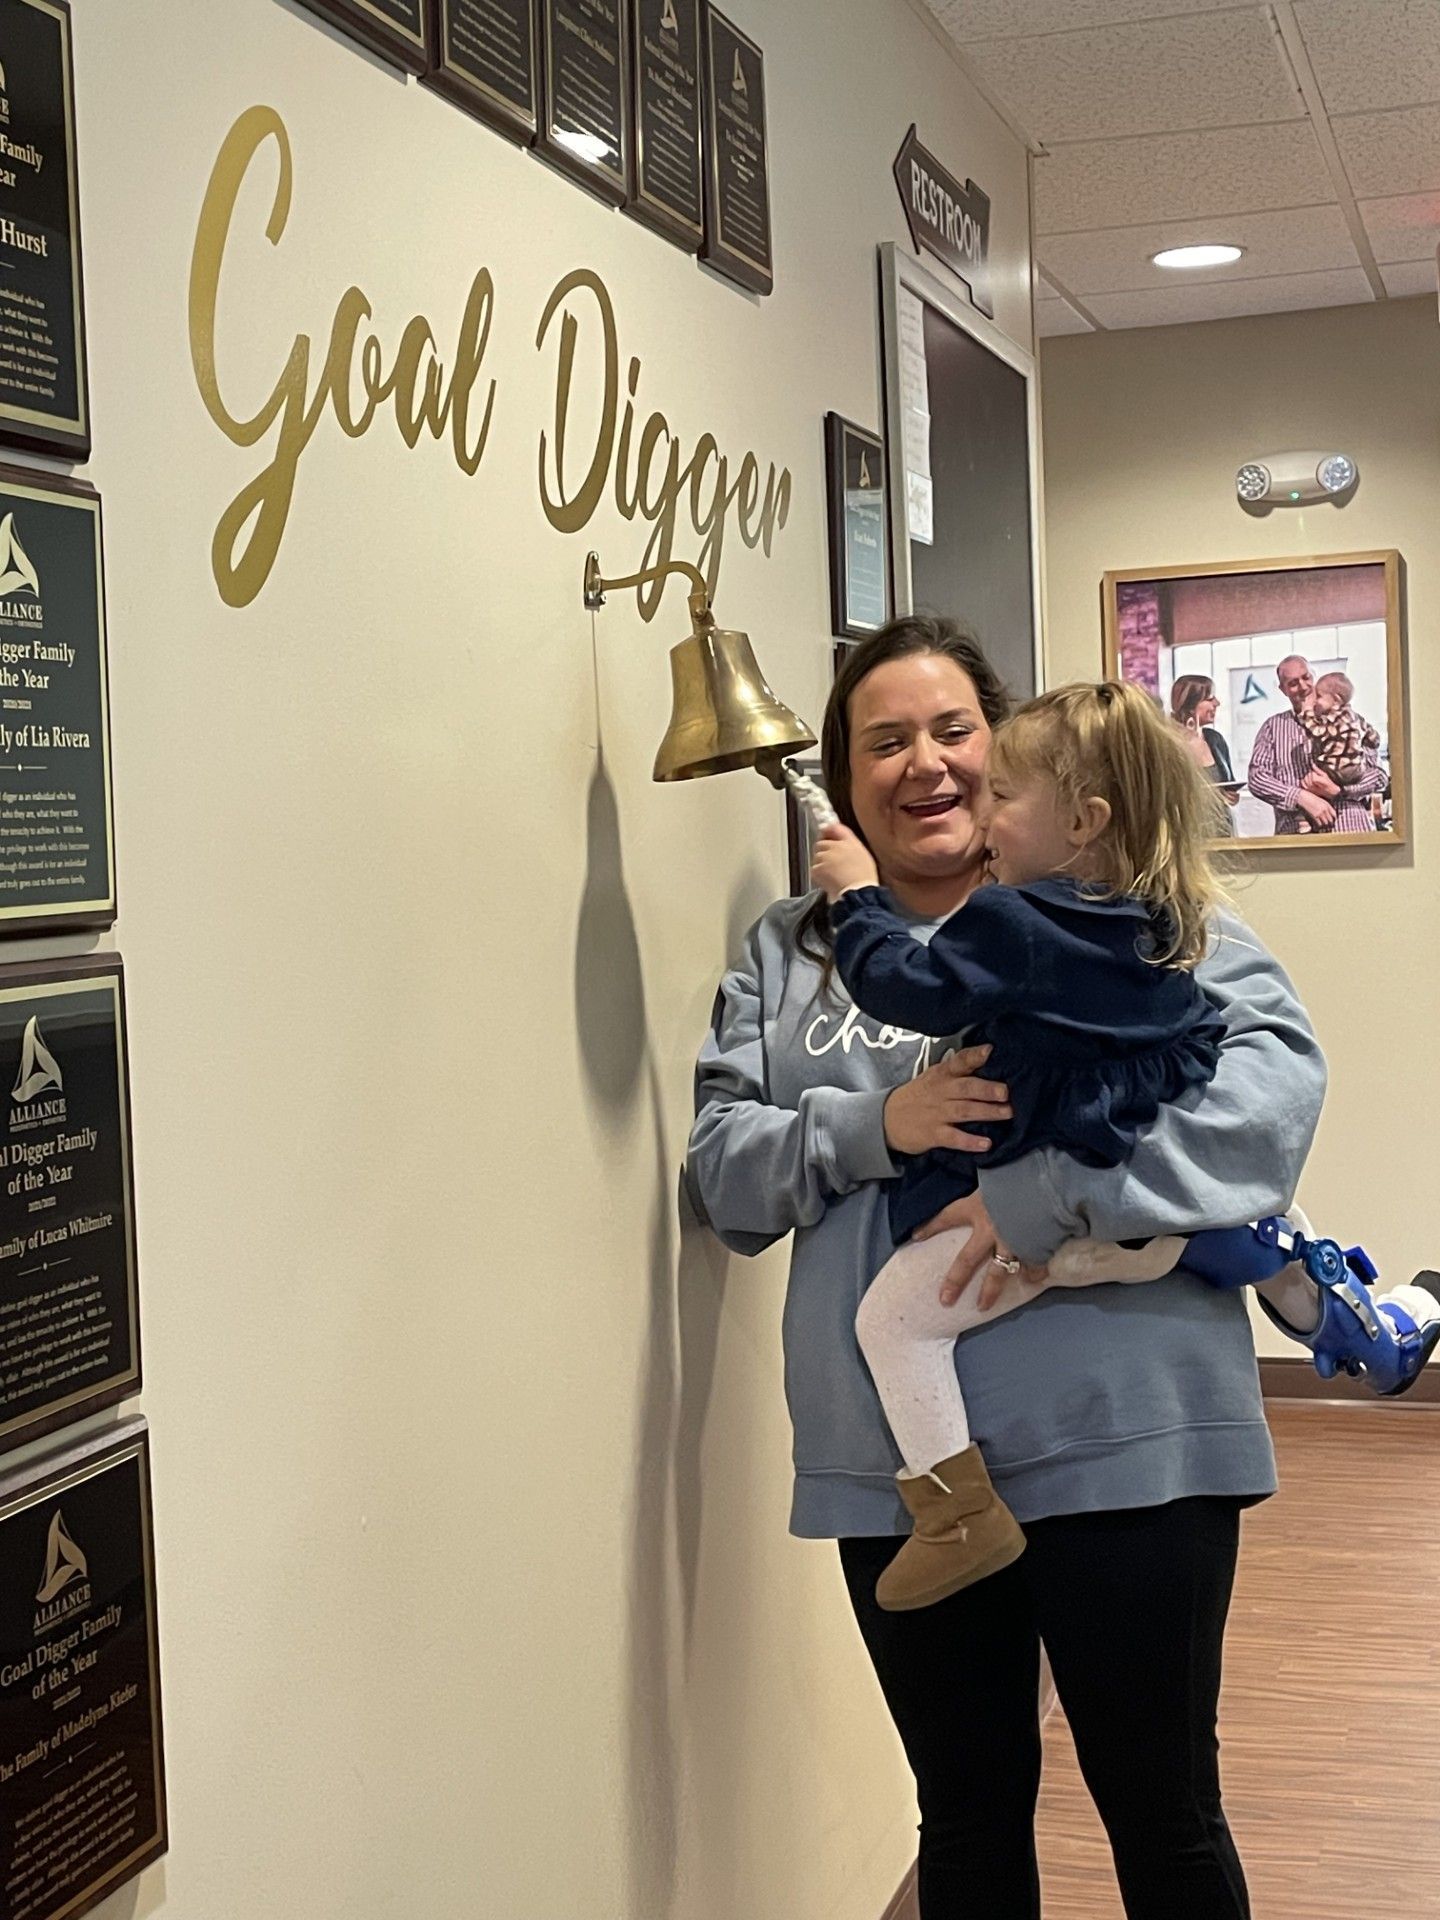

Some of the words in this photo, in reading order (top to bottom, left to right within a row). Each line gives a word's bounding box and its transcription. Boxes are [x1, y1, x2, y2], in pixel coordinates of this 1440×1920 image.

[0, 132, 43, 173] Family
[911, 158, 981, 268] RESTROOM
[0, 218, 48, 257] Hurst
[189, 105, 495, 608] Goal
[536, 269, 791, 623] Digger
[33, 641, 76, 668] Family
[22, 669, 50, 689] Year
[15, 725, 29, 747] of
[31, 726, 51, 747] Lia
[53, 727, 91, 750] Rivera
[9, 1098, 67, 1125] ALLIANCE
[11, 1138, 56, 1167] Digger
[57, 1126, 98, 1154] Family
[8, 1173, 21, 1195] of
[24, 1170, 44, 1191] the
[47, 1164, 73, 1188] Year
[28, 1233, 40, 1251] of
[40, 1226, 68, 1247] Lucas
[69, 1212, 113, 1237] Whitmire
[33, 1583, 91, 1629] ALLIANCE
[1, 1652, 33, 1688] Goal
[36, 1629, 80, 1668] Digger
[82, 1604, 122, 1641] Family
[32, 1673, 46, 1700] of
[49, 1667, 69, 1690] the
[71, 1649, 98, 1678] Year
[16, 1737, 49, 1774] Family
[51, 1730, 61, 1750] of
